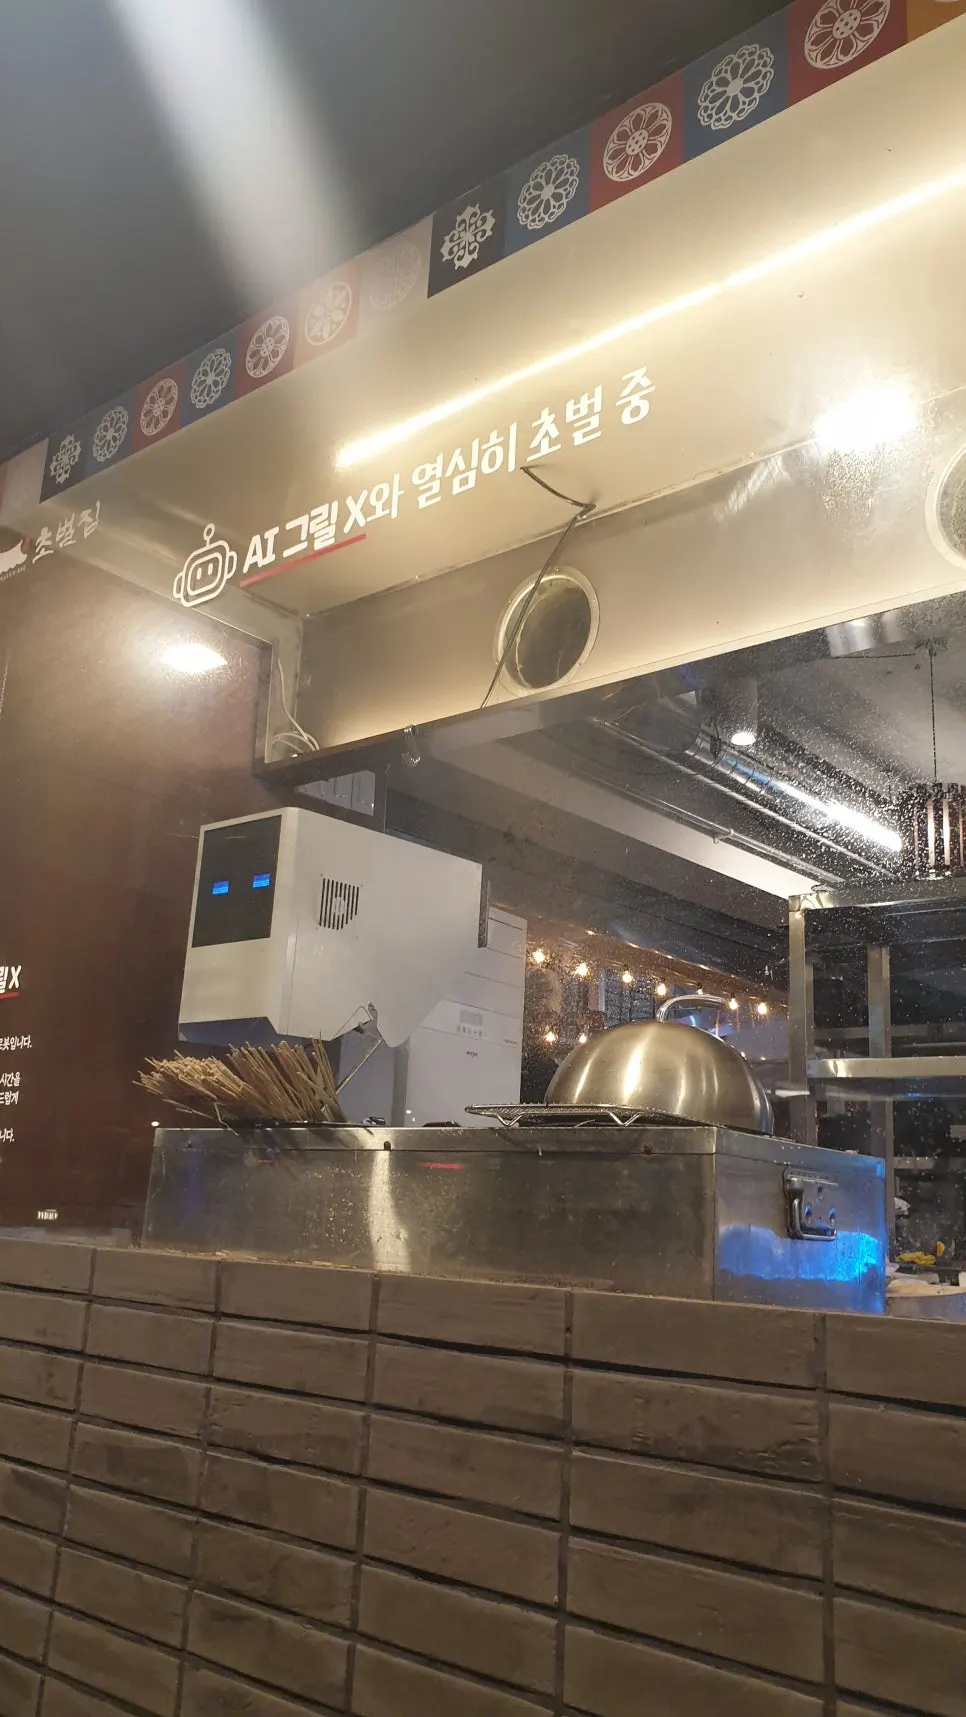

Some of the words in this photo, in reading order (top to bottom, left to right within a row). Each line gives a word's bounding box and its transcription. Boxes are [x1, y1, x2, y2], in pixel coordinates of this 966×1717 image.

[242, 526, 280, 574] AI
[282, 500, 340, 552] 그릴
[343, 474, 405, 534] X와
[411, 421, 518, 510] 열심히
[526, 384, 603, 463] 초벌
[615, 366, 656, 425] 중
